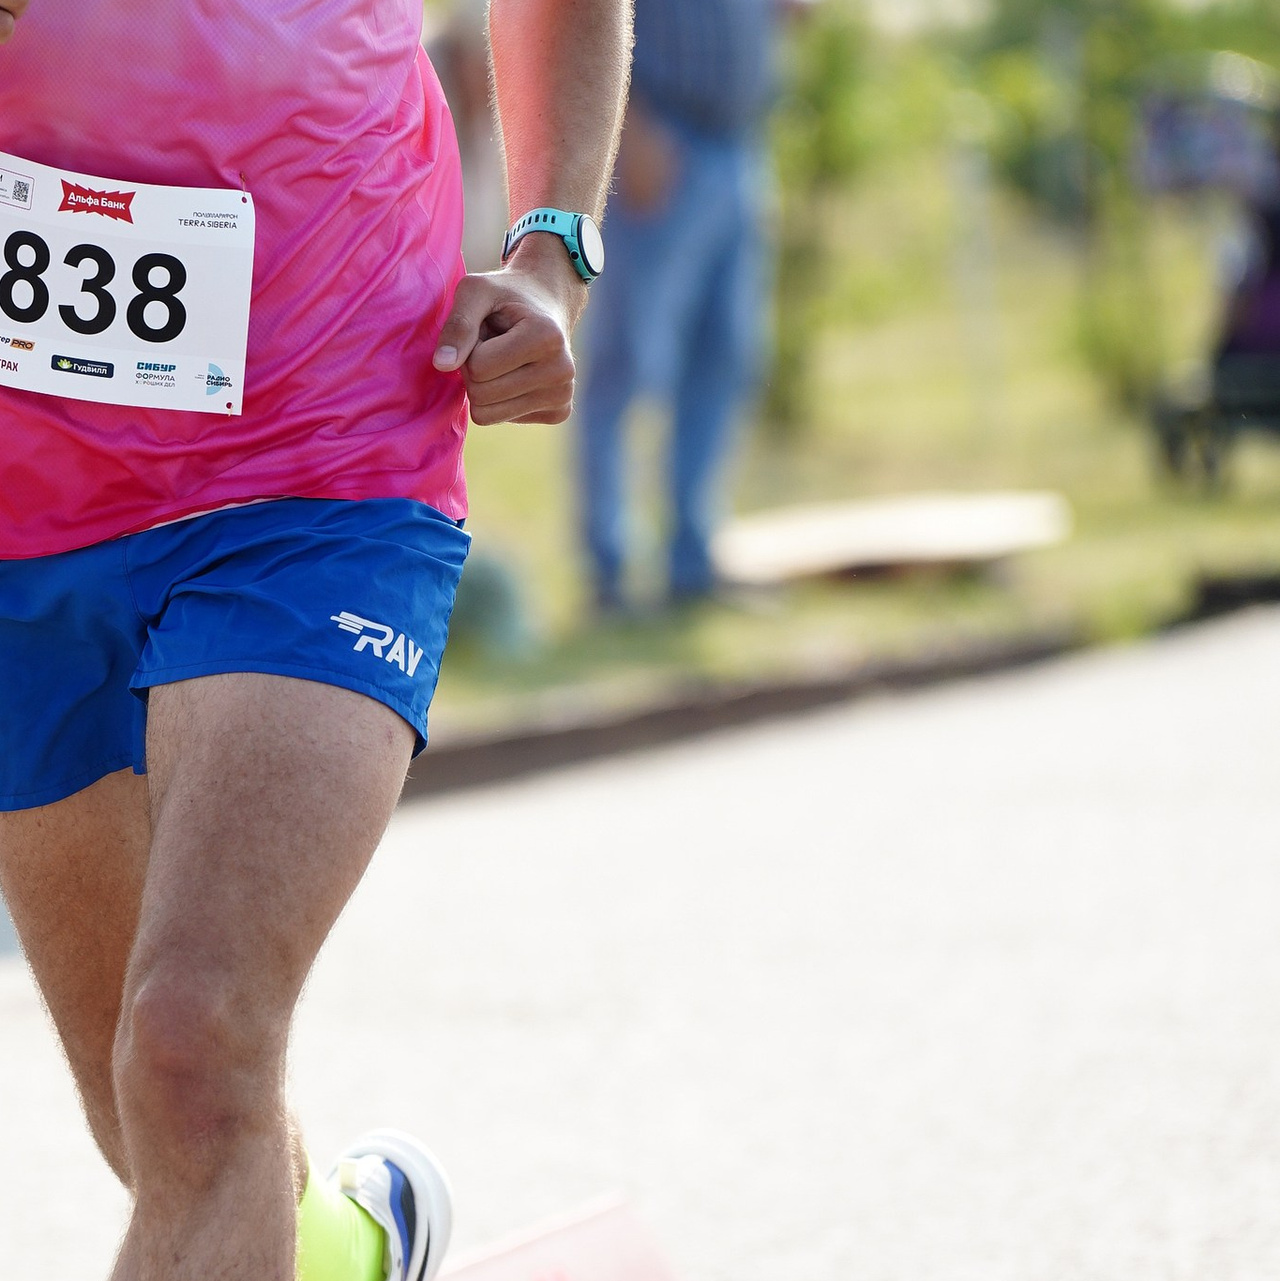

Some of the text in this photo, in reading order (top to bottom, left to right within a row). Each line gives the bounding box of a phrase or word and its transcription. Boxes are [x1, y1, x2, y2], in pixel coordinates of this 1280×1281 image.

[68, 192, 126, 210] Альфа Банк
[179, 219, 237, 229] TERRA SIBERIA
[11, 339, 34, 351] PRO
[73, 363, 107, 375] Гудвилл
[136, 362, 176, 373] СИБУР
[136, 372, 175, 382] ФОРМУЛА
[206, 380, 232, 388] СИБИРЬ
